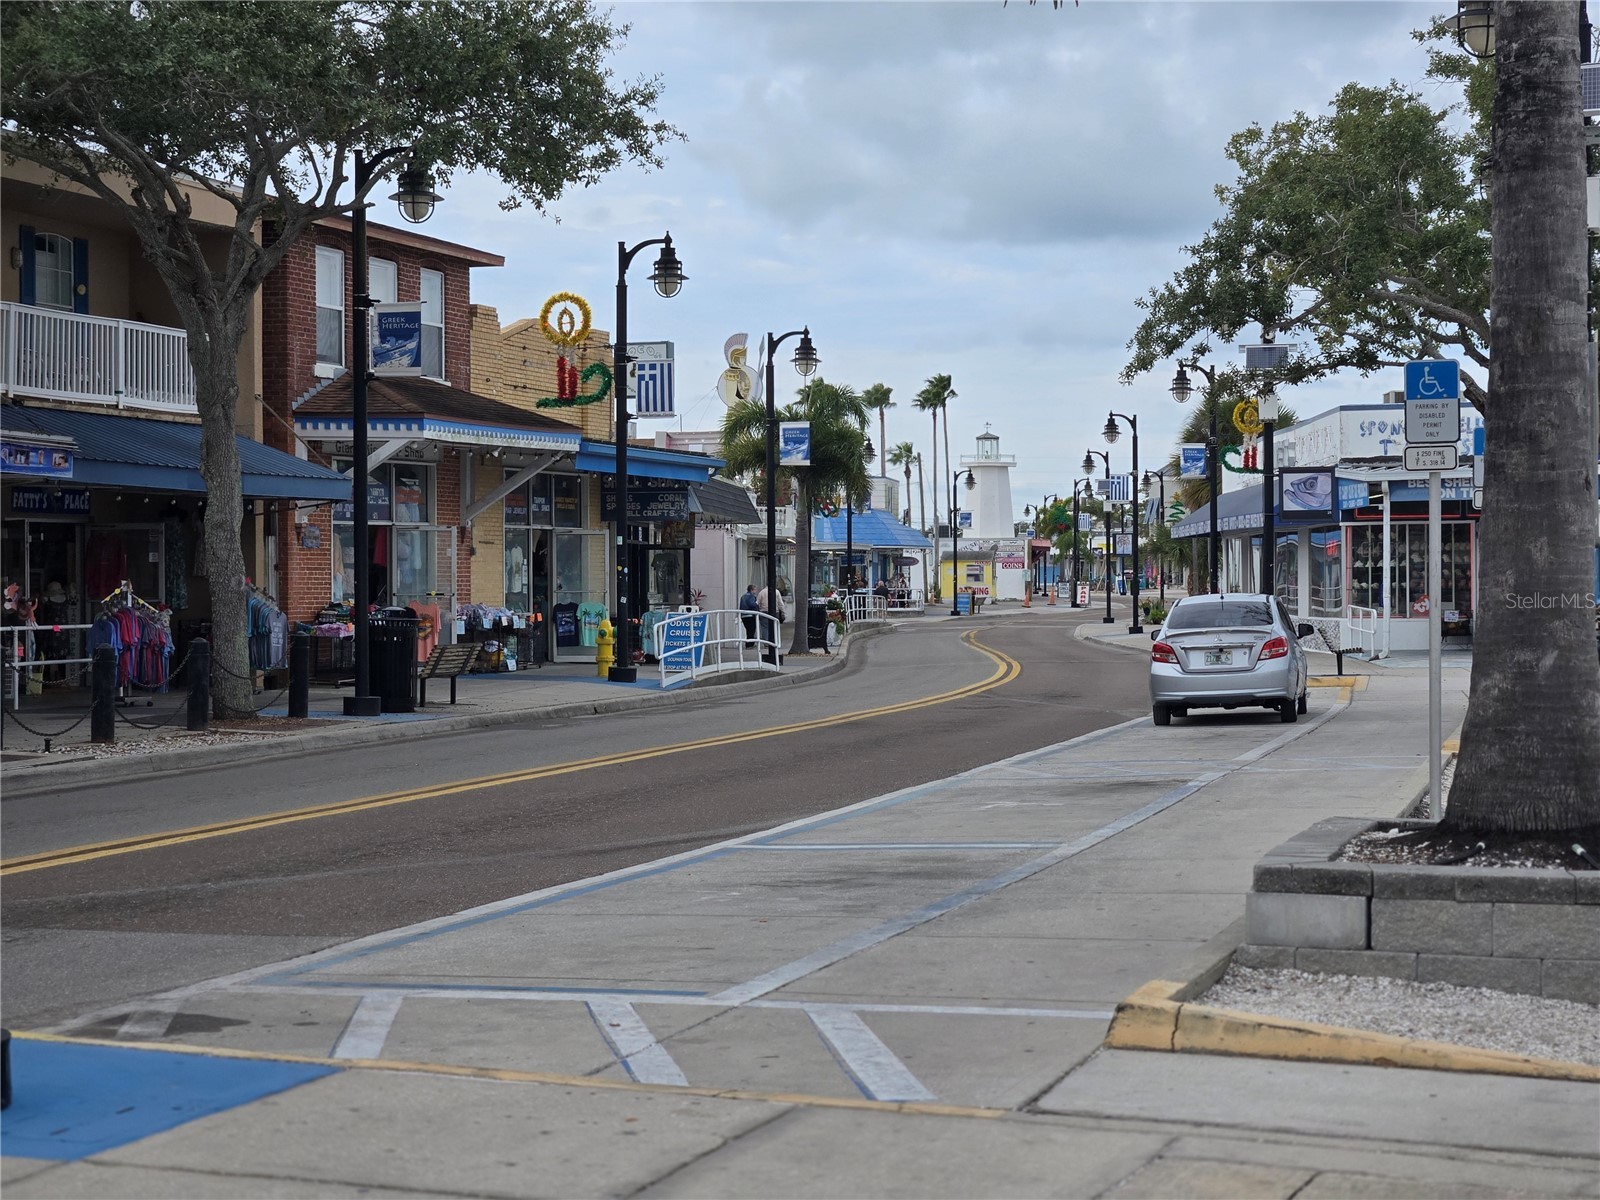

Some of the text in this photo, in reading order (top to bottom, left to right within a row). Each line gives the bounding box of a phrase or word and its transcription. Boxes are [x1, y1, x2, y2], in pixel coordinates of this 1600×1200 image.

[1407, 479, 1430, 488] BES
[657, 494, 684, 502] CORAL
[1440, 488, 1455, 499] ON
[13, 491, 89, 510] FATTY'S PLACE
[647, 501, 685, 510] JEWELRY
[669, 629, 701, 637] CRUISS
